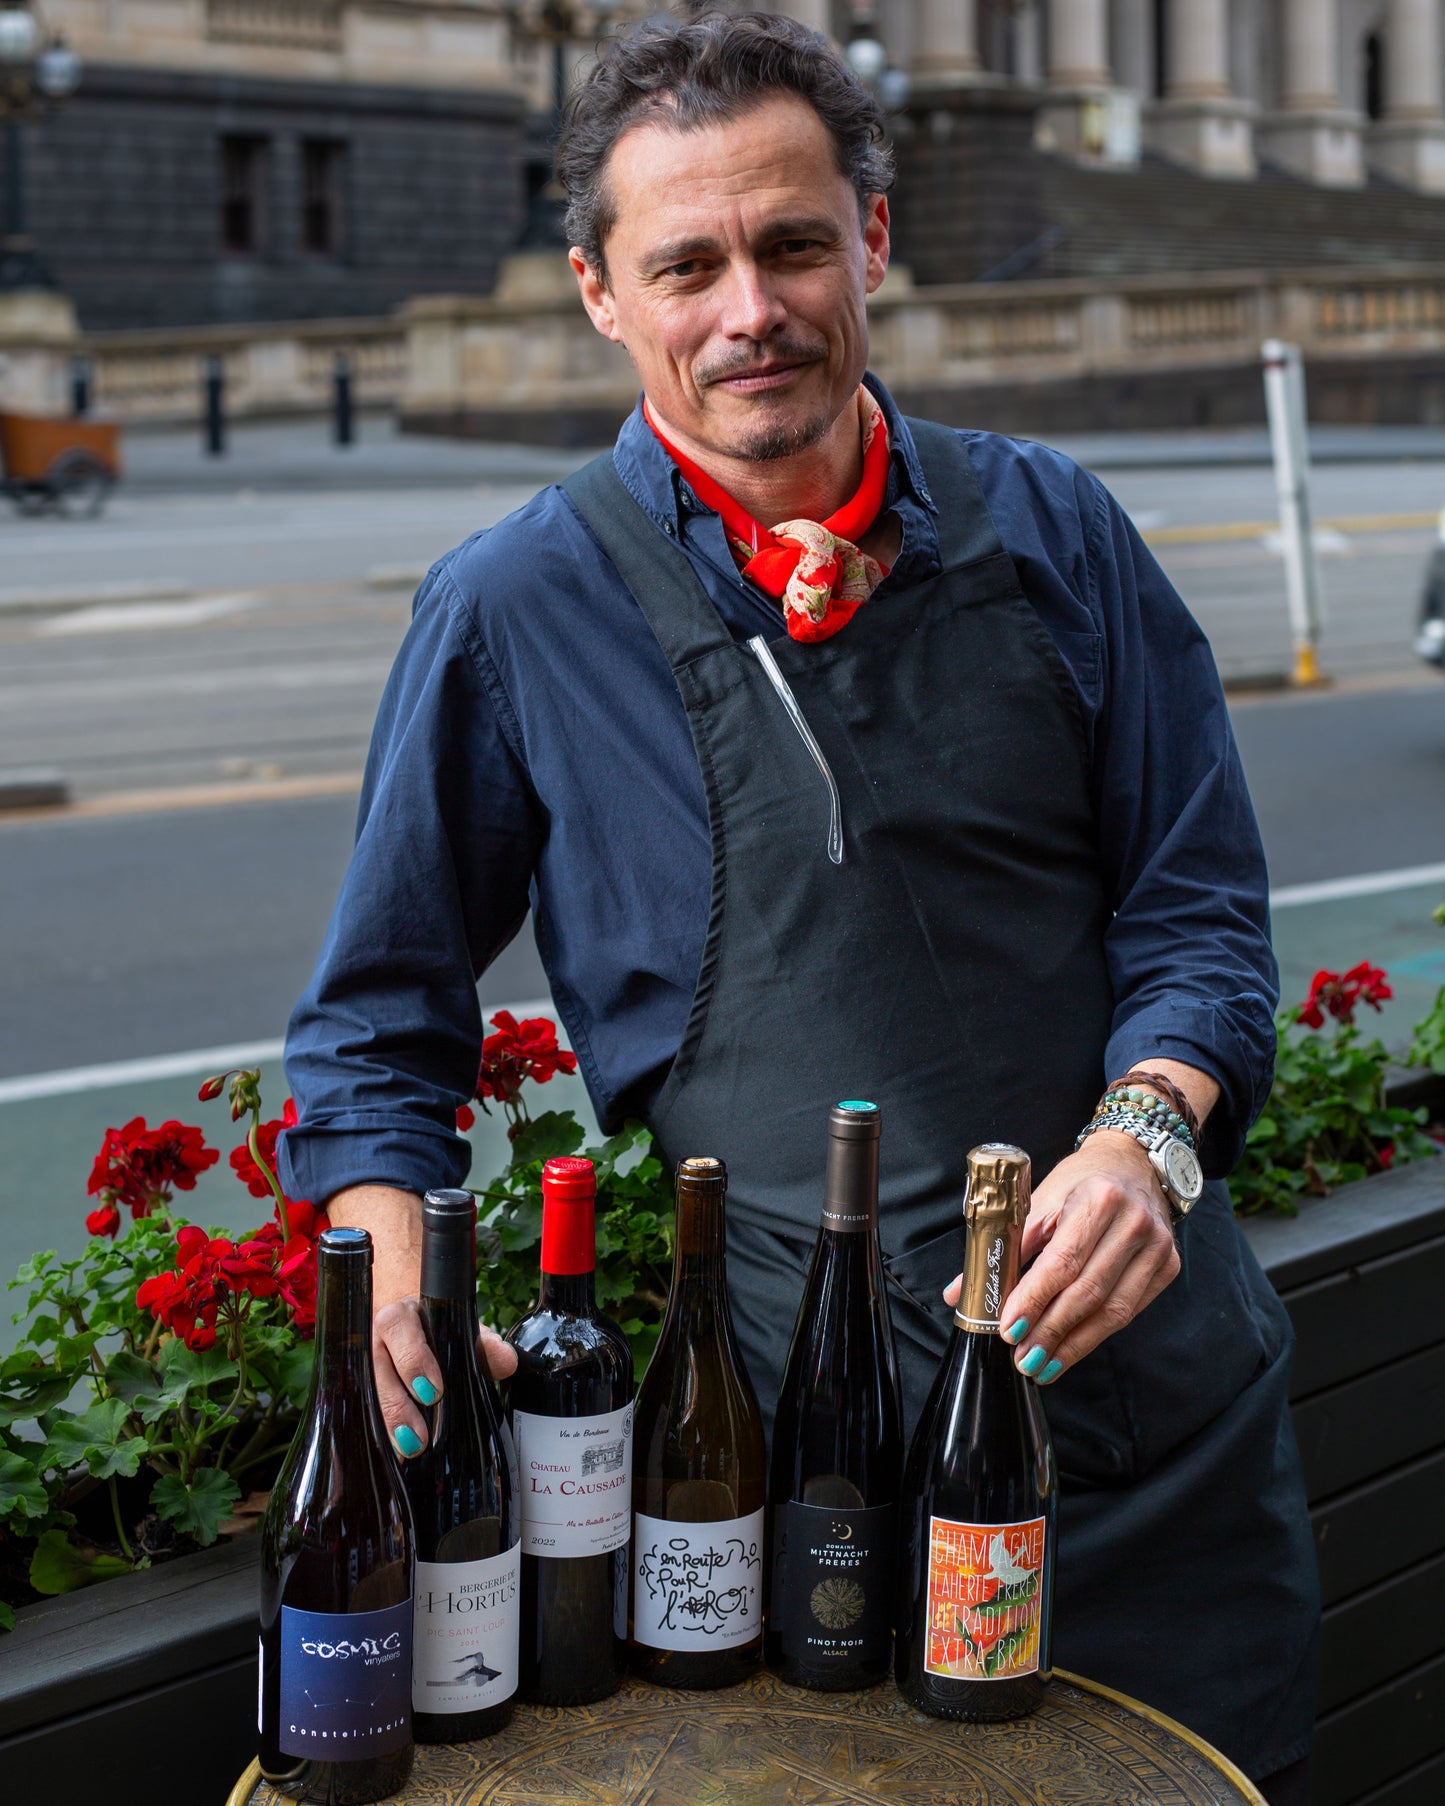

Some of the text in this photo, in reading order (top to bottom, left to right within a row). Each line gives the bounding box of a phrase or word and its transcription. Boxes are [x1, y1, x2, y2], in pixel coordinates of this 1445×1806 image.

[559, 1430, 571, 1438] Vin
[583, 1429, 609, 1437] Bordeaux
[530, 1461, 571, 1473] CHATEAU
[531, 1477, 553, 1495] LA
[559, 1474, 627, 1496] CAUSSADE
[531, 1537, 556, 1546] 2022
[935, 1527, 1041, 1569] CHAMPAGNE
[810, 1548, 869, 1558] MITTNACHT
[818, 1558, 860, 1567] FRERES
[460, 1575, 507, 1594] BERGERIE
[934, 1567, 989, 1602] LAHERTE
[931, 1600, 1038, 1636] ULTRADITION
[427, 1618, 505, 1638] PIC SAINT LOUP
[807, 1637, 864, 1647] PINOT NOIR
[364, 1651, 401, 1666] vinyaters
[930, 1632, 1035, 1671] EXTRA-BRUT
